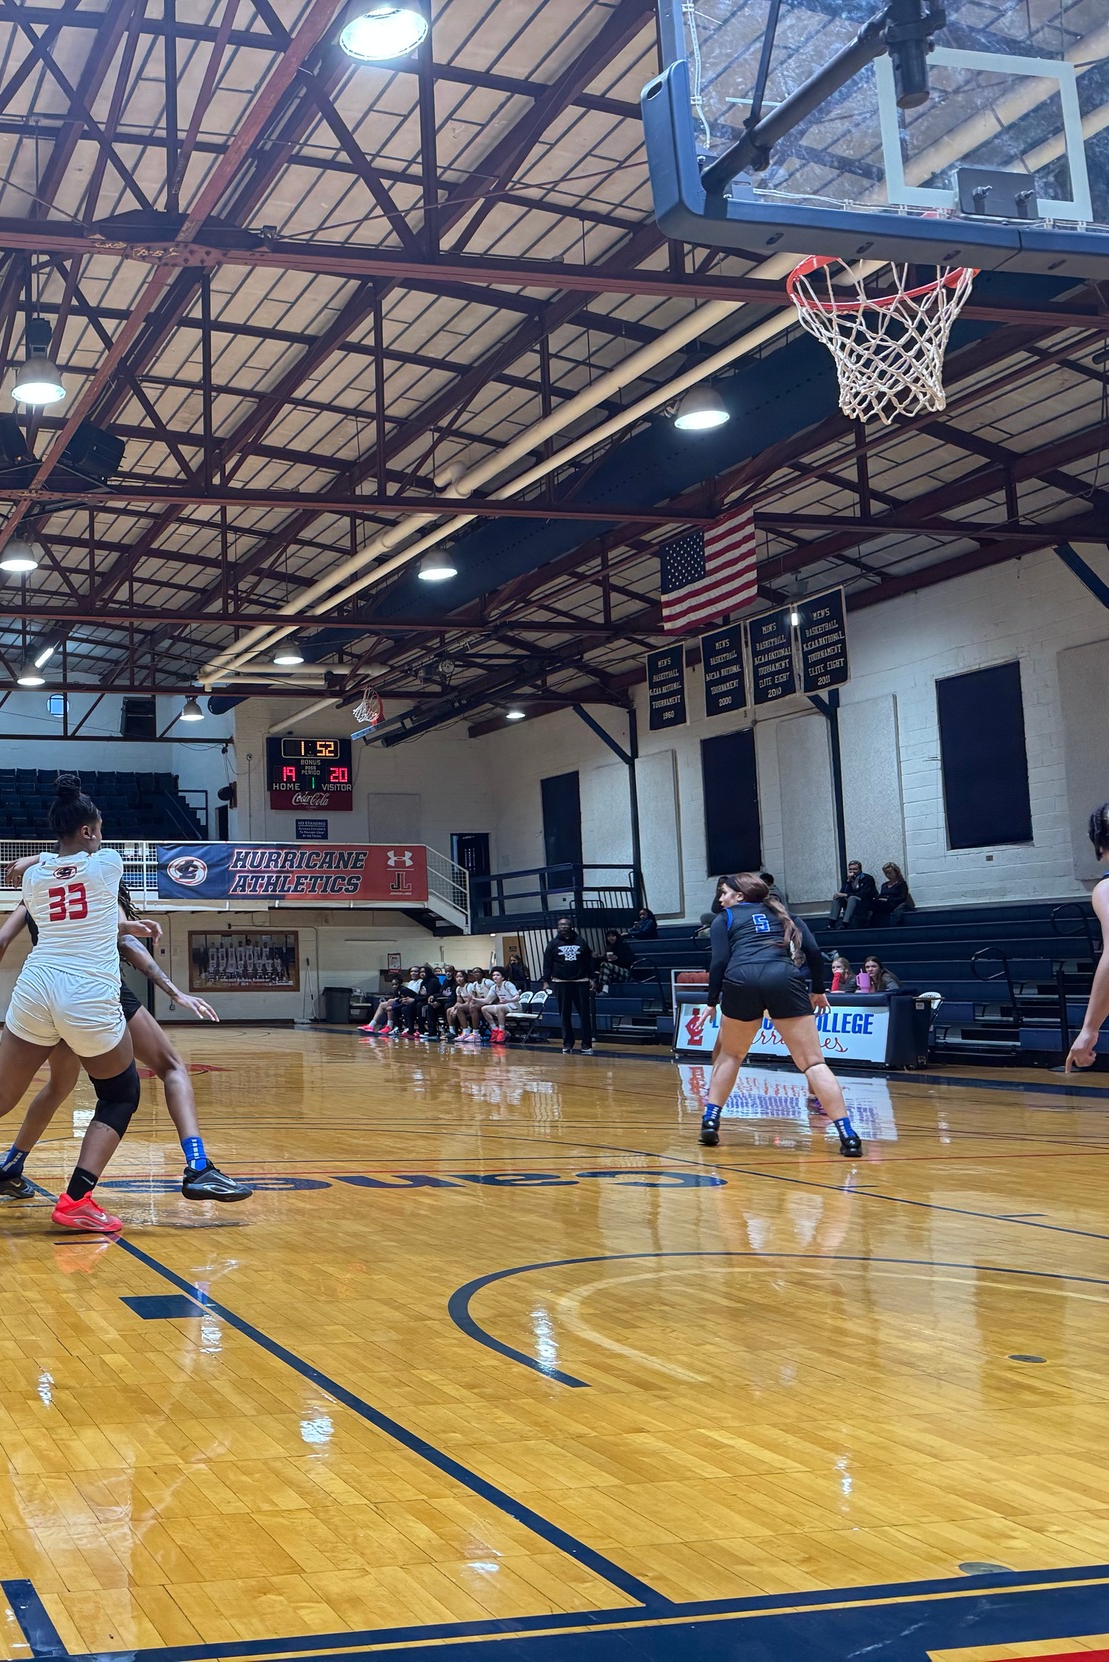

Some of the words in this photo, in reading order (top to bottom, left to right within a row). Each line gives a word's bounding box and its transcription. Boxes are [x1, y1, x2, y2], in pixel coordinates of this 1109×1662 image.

[805, 620, 839, 638] BASKETBALL
[756, 635, 786, 651] BASKETBALL
[808, 644, 842, 663] TOURNAMENT
[808, 664, 825, 677] ELITE
[827, 658, 844, 671] EIGHT
[283, 766, 296, 781] 19
[330, 767, 348, 782] 20
[273, 783, 300, 791] HOME
[292, 791, 330, 806] Coca-Cola
[229, 849, 368, 871] HURRICANE
[228, 874, 362, 895] ATHLETICS
[48, 882, 88, 922] 33
[752, 913, 771, 933] 5
